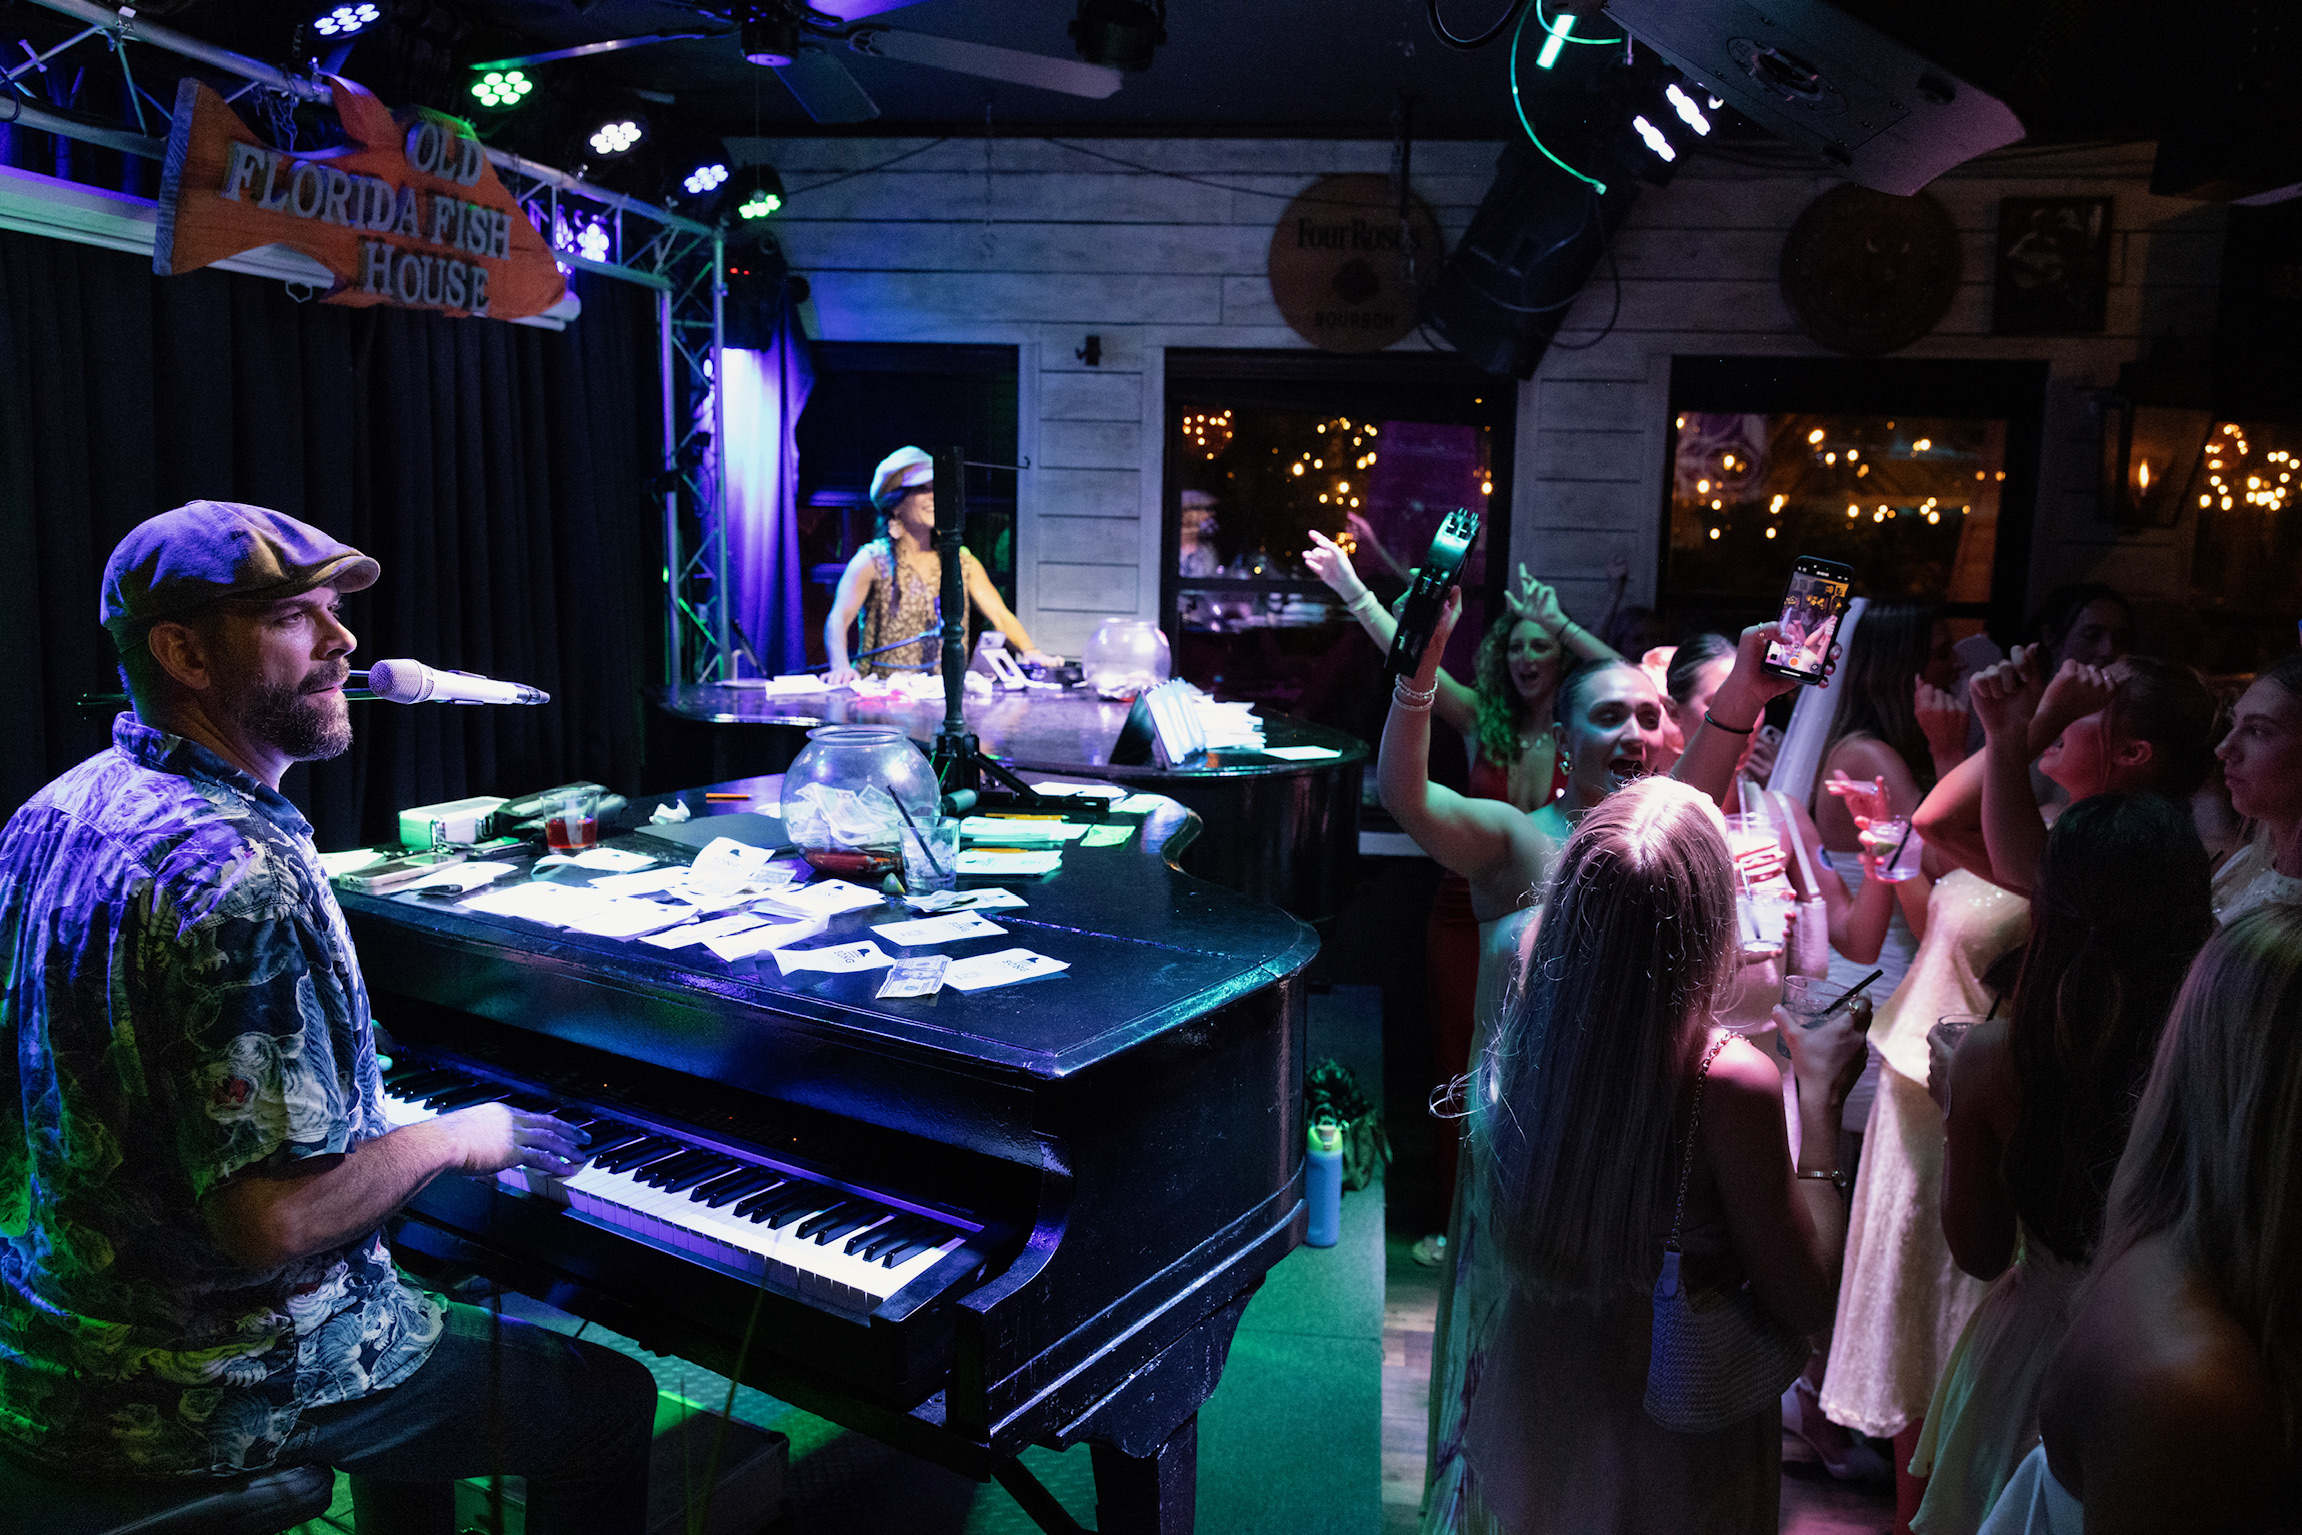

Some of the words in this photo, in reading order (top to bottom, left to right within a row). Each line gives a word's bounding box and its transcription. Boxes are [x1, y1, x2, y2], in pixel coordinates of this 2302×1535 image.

[408, 121, 484, 187] OLD
[221, 139, 421, 240] FLORIDA
[429, 194, 513, 261] FISH
[1297, 217, 1349, 249] Four
[362, 238, 489, 318] HOUSE
[1314, 310, 1397, 329] BOURBON
[833, 949, 856, 964] SONG
